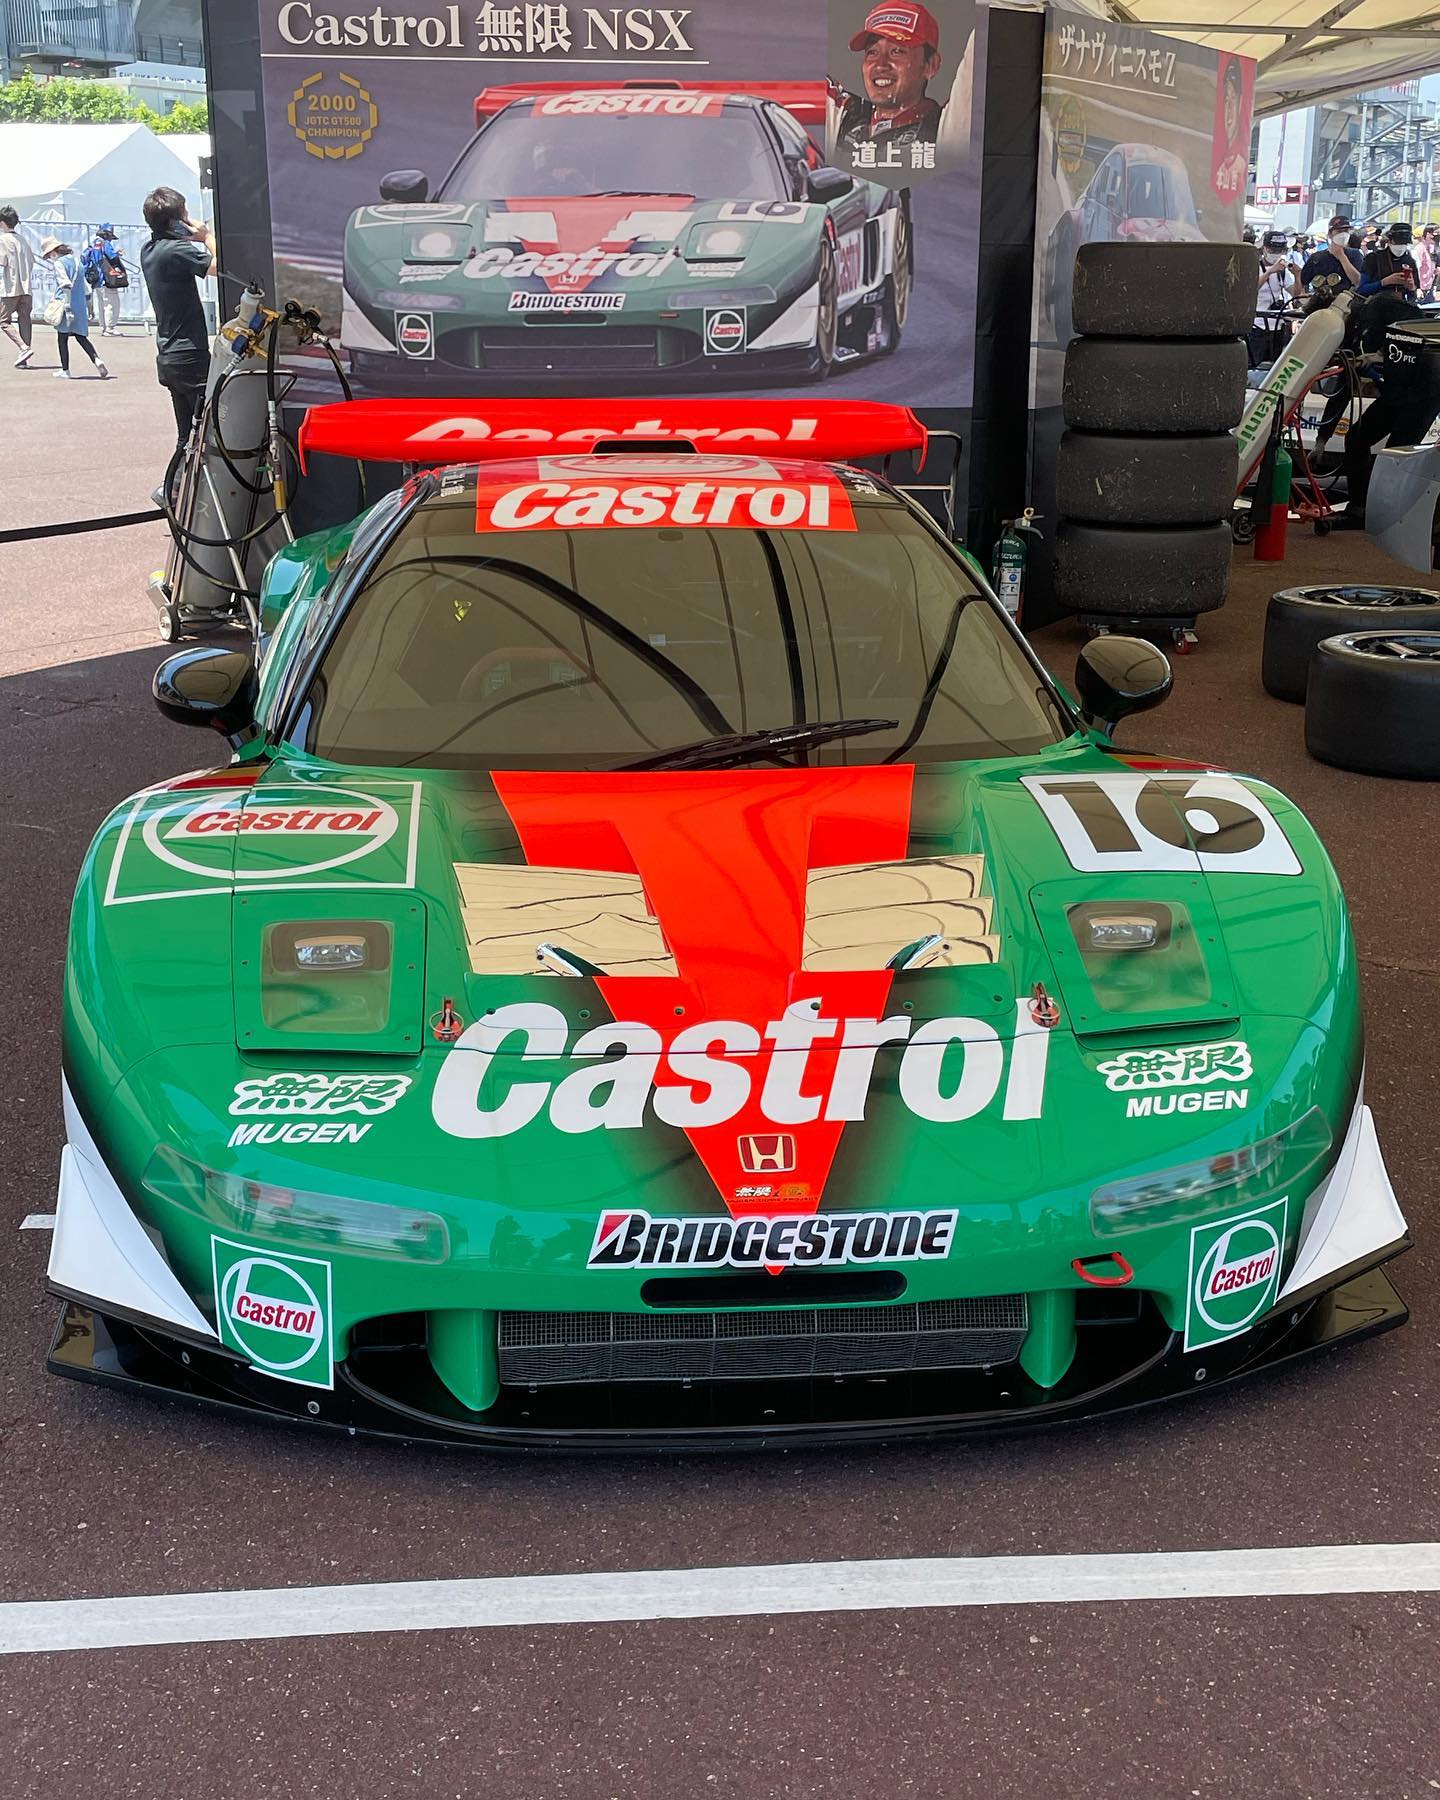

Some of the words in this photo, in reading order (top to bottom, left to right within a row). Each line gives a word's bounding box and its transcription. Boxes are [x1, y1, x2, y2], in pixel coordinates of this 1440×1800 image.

[277, 1, 465, 48] Castrol
[475, 1, 573, 53] 無限
[583, 8, 694, 51] NSX
[308, 94, 356, 111] 2000
[542, 94, 714, 115] Castrol
[304, 116, 329, 126] JGTC
[331, 117, 361, 126] GT500
[307, 127, 360, 137] CHAMPION
[851, 140, 903, 169] 道上
[910, 141, 936, 169] 龍
[463, 246, 679, 279] Castrol
[511, 293, 623, 310] BRIDGESTONE
[402, 328, 429, 341] Castrol
[713, 325, 741, 336] Castrol
[489, 481, 829, 528] Castrol
[185, 809, 384, 834] Castrol
[1039, 779, 1265, 854] 16
[430, 996, 1053, 1139] Castrol
[1096, 1041, 1253, 1092] 無限
[228, 1073, 412, 1116] 無限
[1126, 1089, 1249, 1118] MUGEN
[227, 1122, 373, 1149] MUGEN
[588, 1211, 957, 1267] BRIDGESTONE
[1211, 1249, 1277, 1295] Castrol
[236, 1295, 316, 1334] Castrol
